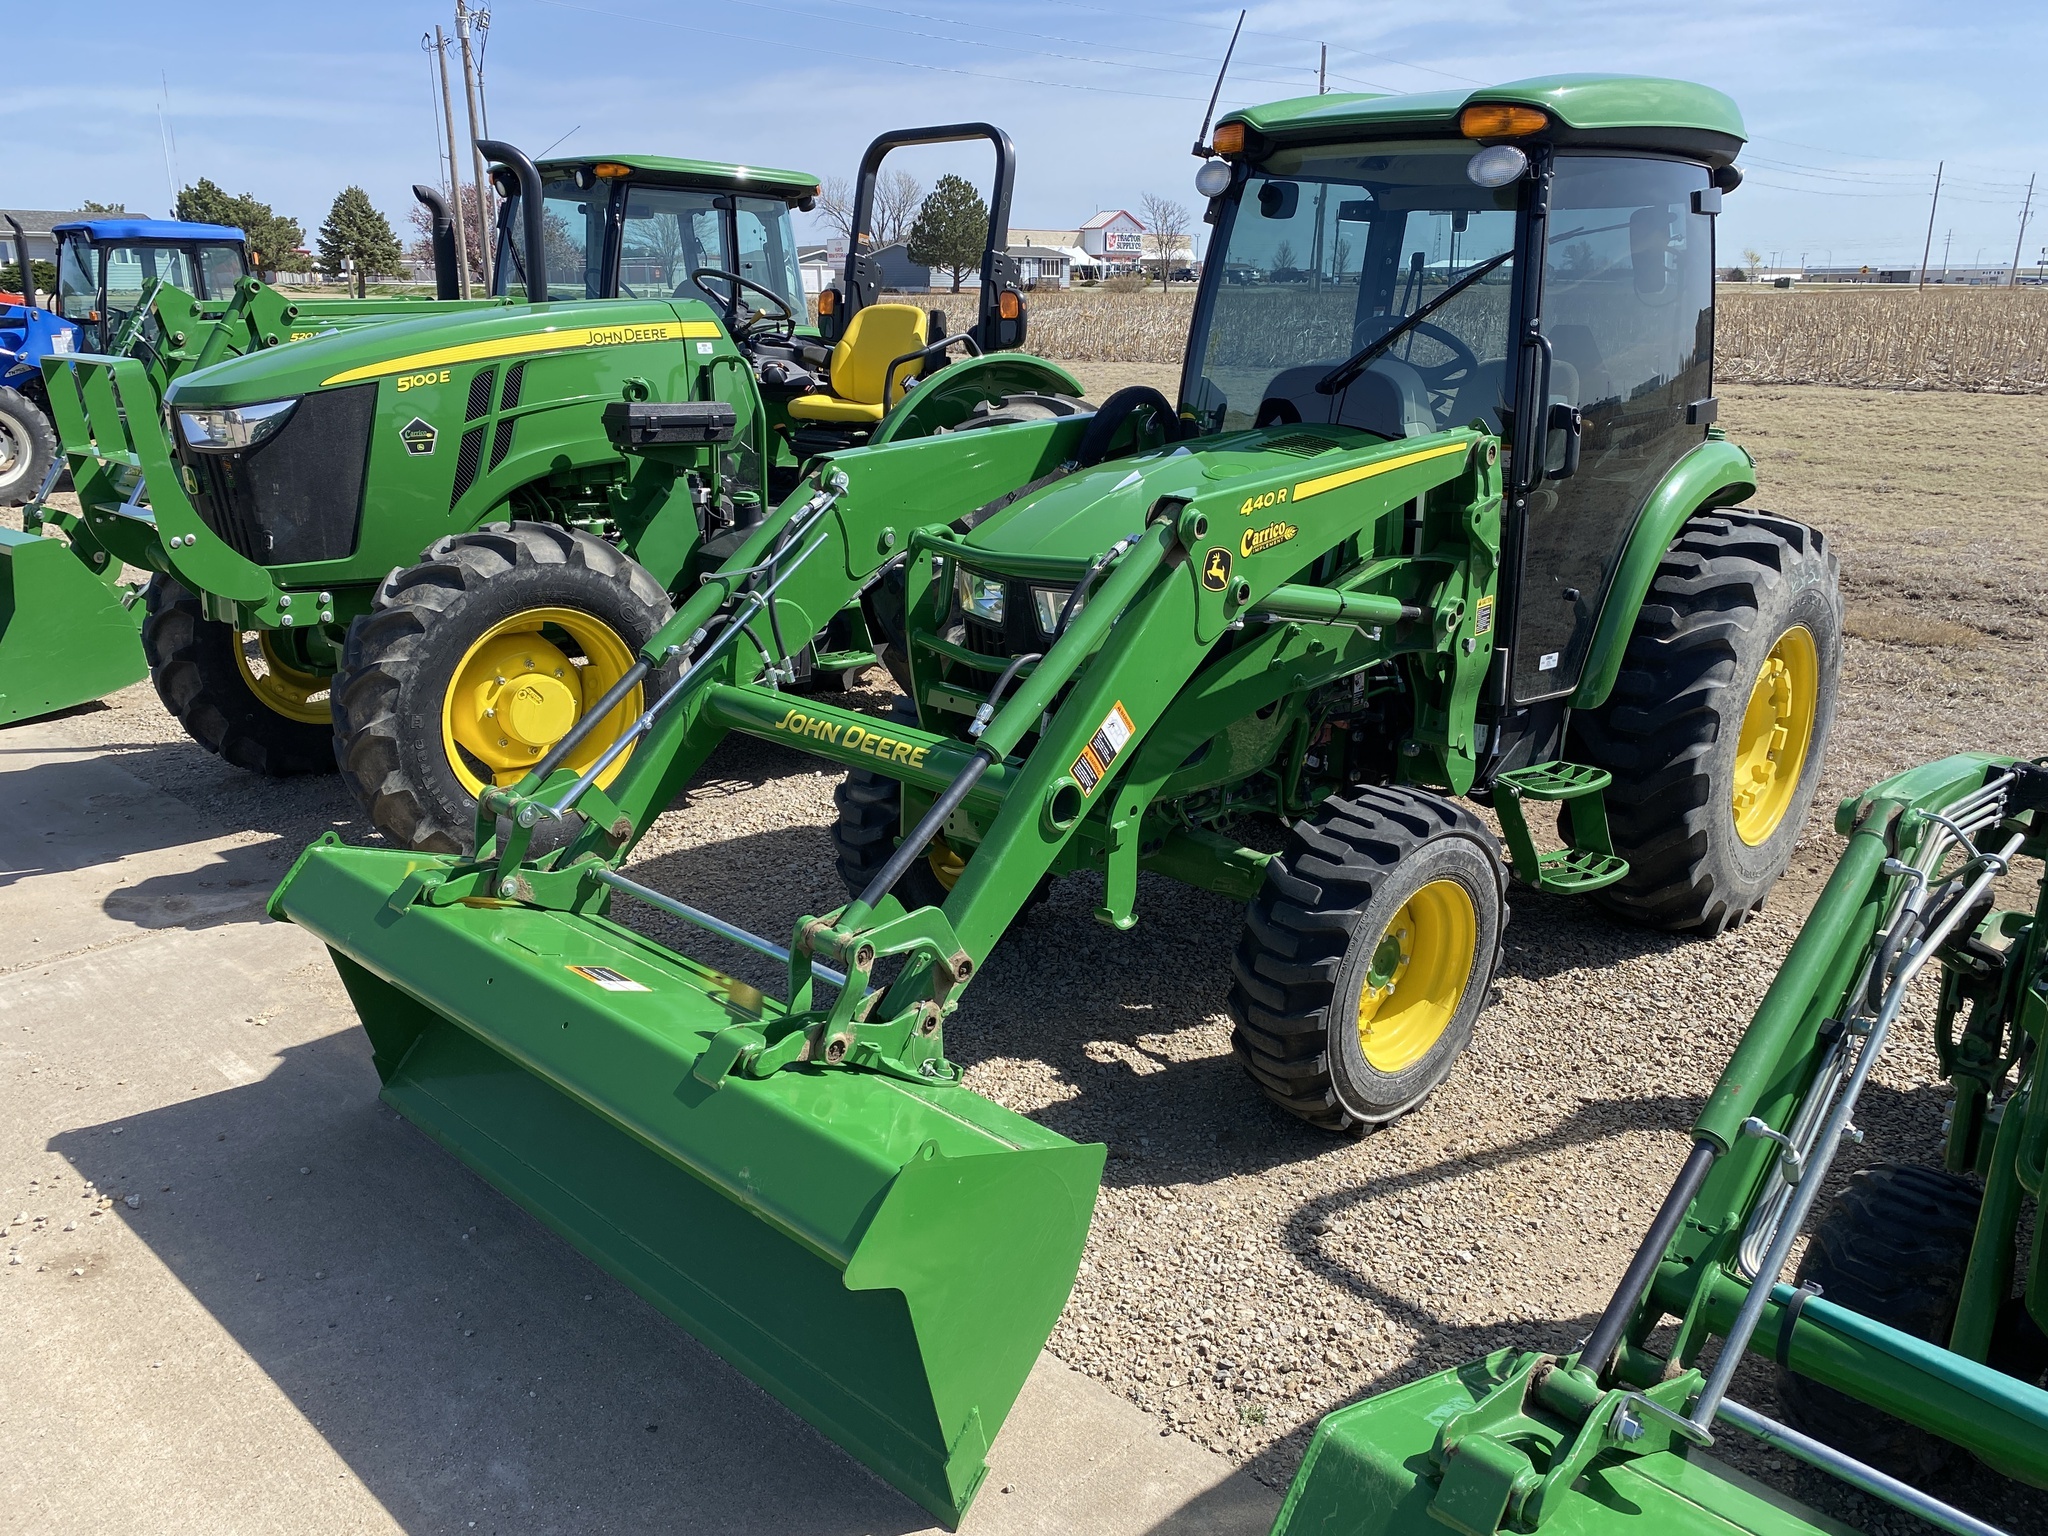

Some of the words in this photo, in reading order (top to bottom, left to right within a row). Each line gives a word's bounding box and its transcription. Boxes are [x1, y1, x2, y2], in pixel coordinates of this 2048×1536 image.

[1116, 234, 1141, 242] TRACTOR
[1116, 241, 1134, 250] SUPPLY
[289, 332, 314, 342] 520
[586, 330, 623, 345] JOHN
[624, 328, 668, 341] DEERE
[397, 372, 438, 393] 5100
[439, 370, 451, 384] E
[1240, 491, 1276, 517] 440
[1276, 487, 1288, 505] R
[1240, 521, 1287, 559] Carrico
[1252, 537, 1285, 554] IMPLEMENT
[775, 709, 843, 744] JOHN
[841, 725, 931, 769] DEERE
